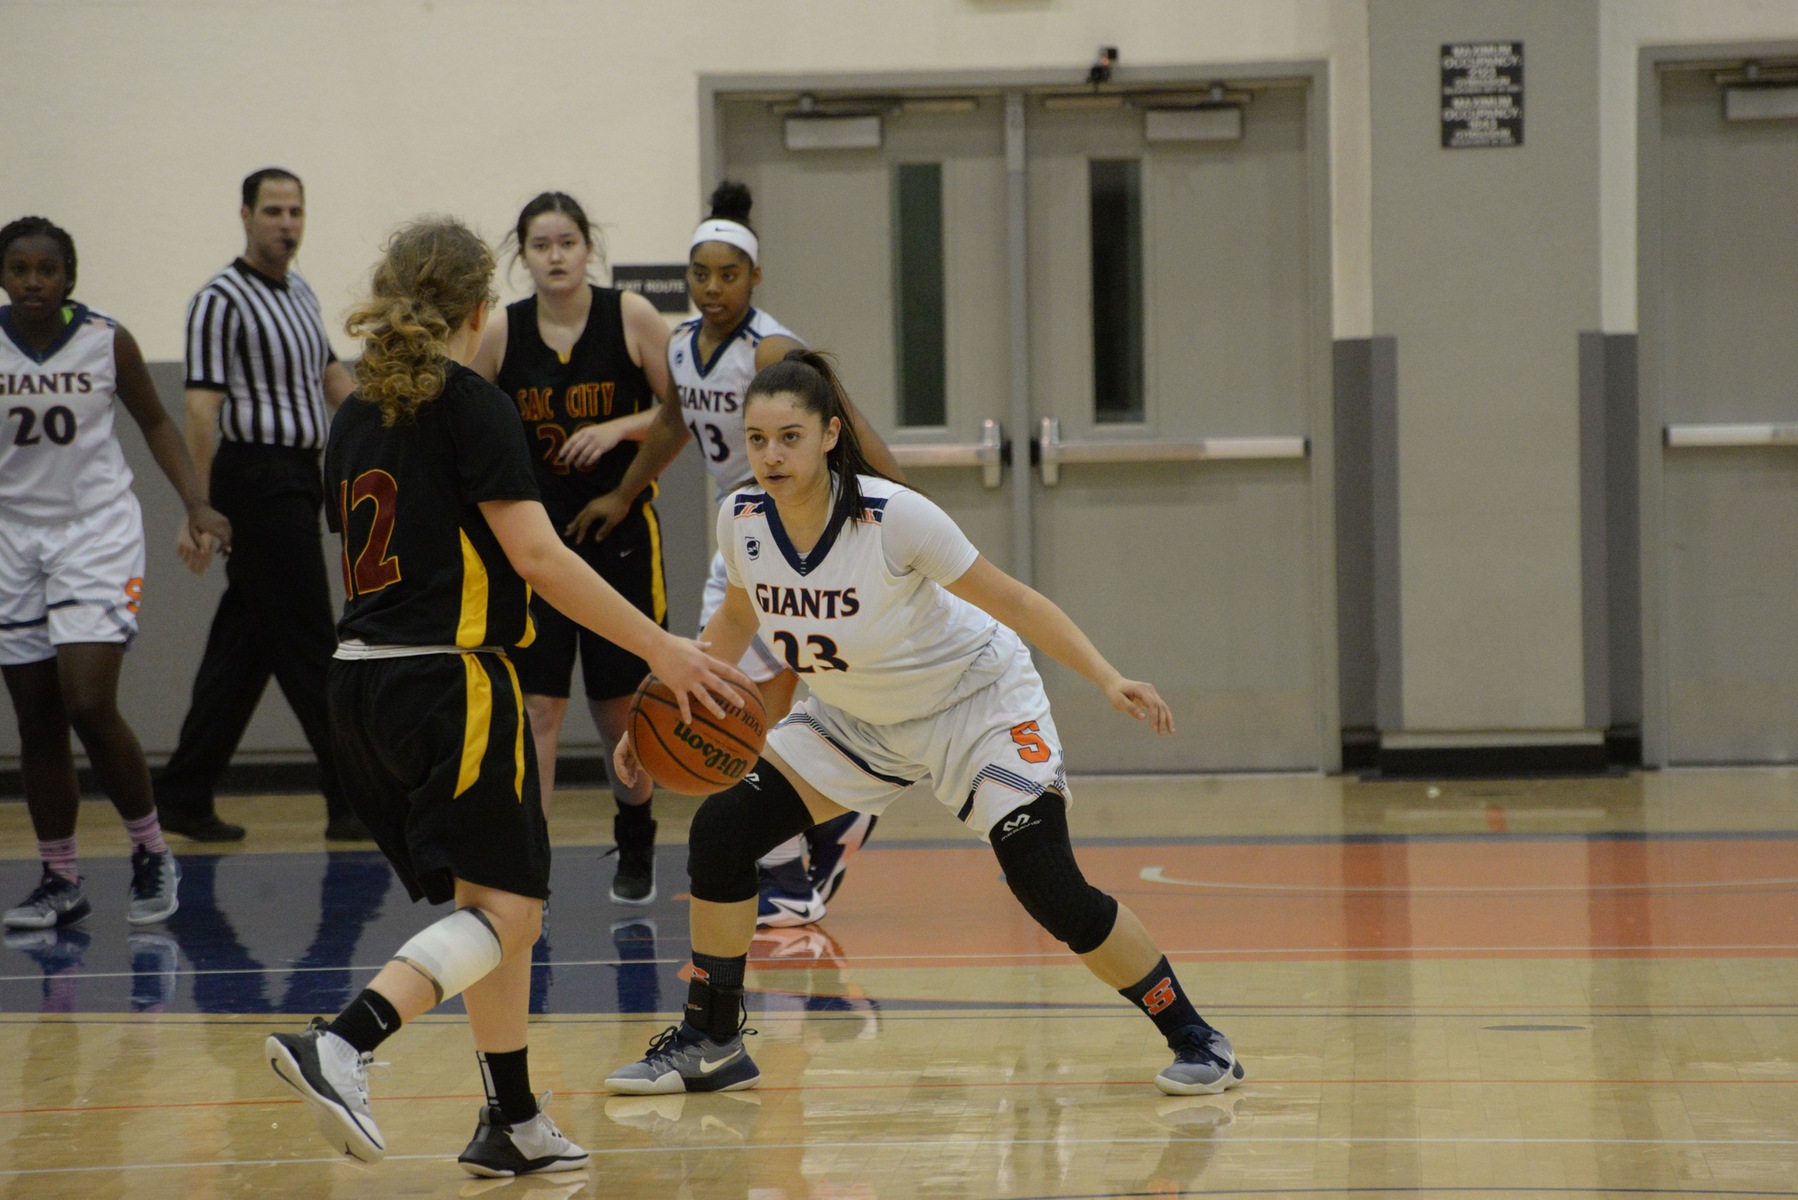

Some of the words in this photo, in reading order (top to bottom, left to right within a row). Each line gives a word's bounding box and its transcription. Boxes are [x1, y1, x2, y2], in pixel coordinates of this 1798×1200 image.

[643, 279, 686, 294] ROUTE
[517, 386, 554, 420] SAC
[565, 381, 615, 418] CITY
[8, 405, 78, 447] 20
[755, 582, 860, 620] GIANTS
[773, 629, 850, 675] 23
[673, 719, 749, 779] Wilson
[1010, 720, 1052, 764] S
[1142, 976, 1177, 1016] S
